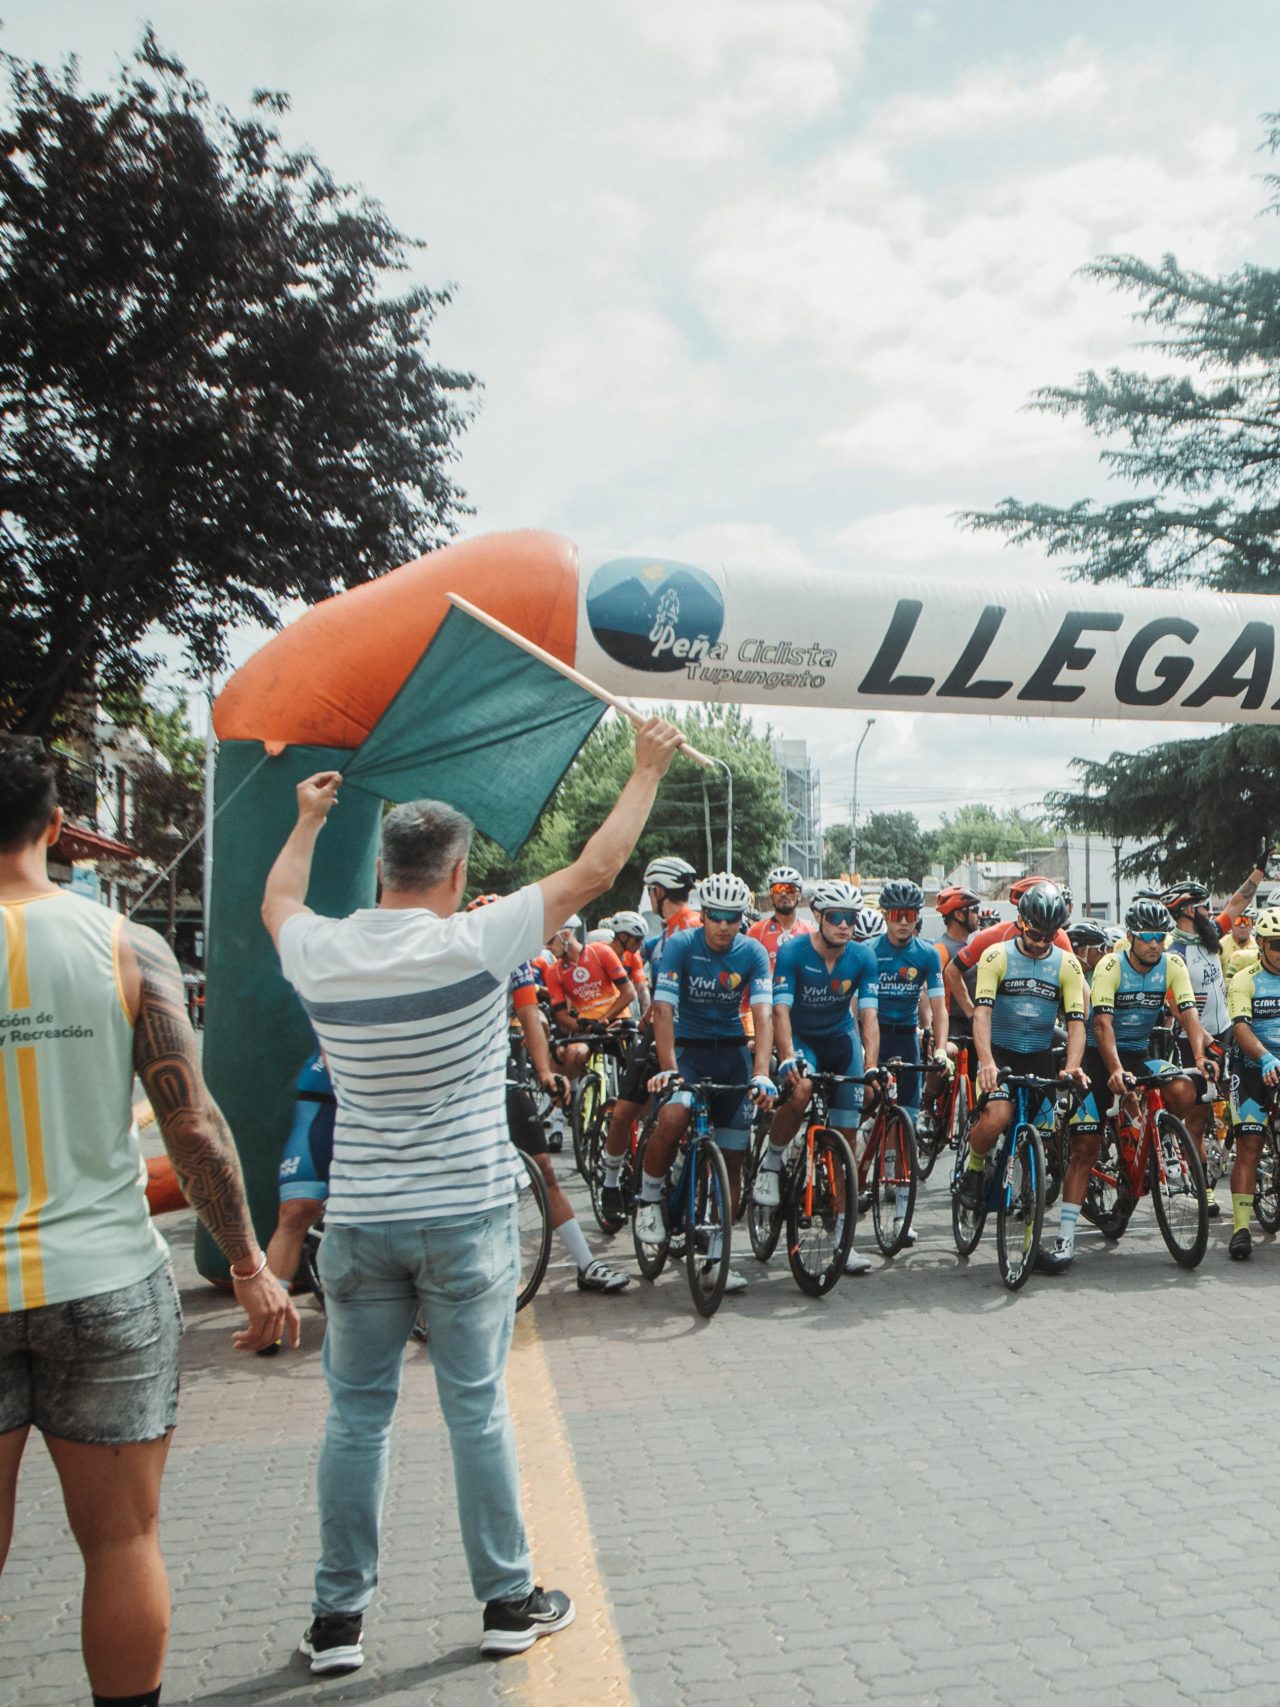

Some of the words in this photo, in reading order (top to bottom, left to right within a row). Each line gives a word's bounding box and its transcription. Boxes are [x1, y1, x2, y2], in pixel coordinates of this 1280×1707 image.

[649, 626, 728, 661] Peña
[738, 639, 838, 667] Ciclista
[685, 661, 826, 689] Tupungato
[689, 976, 717, 990] Viví
[804, 986, 827, 996] Viví
[36, 1012, 54, 1024] de
[10, 1025, 94, 1042] Recreación
